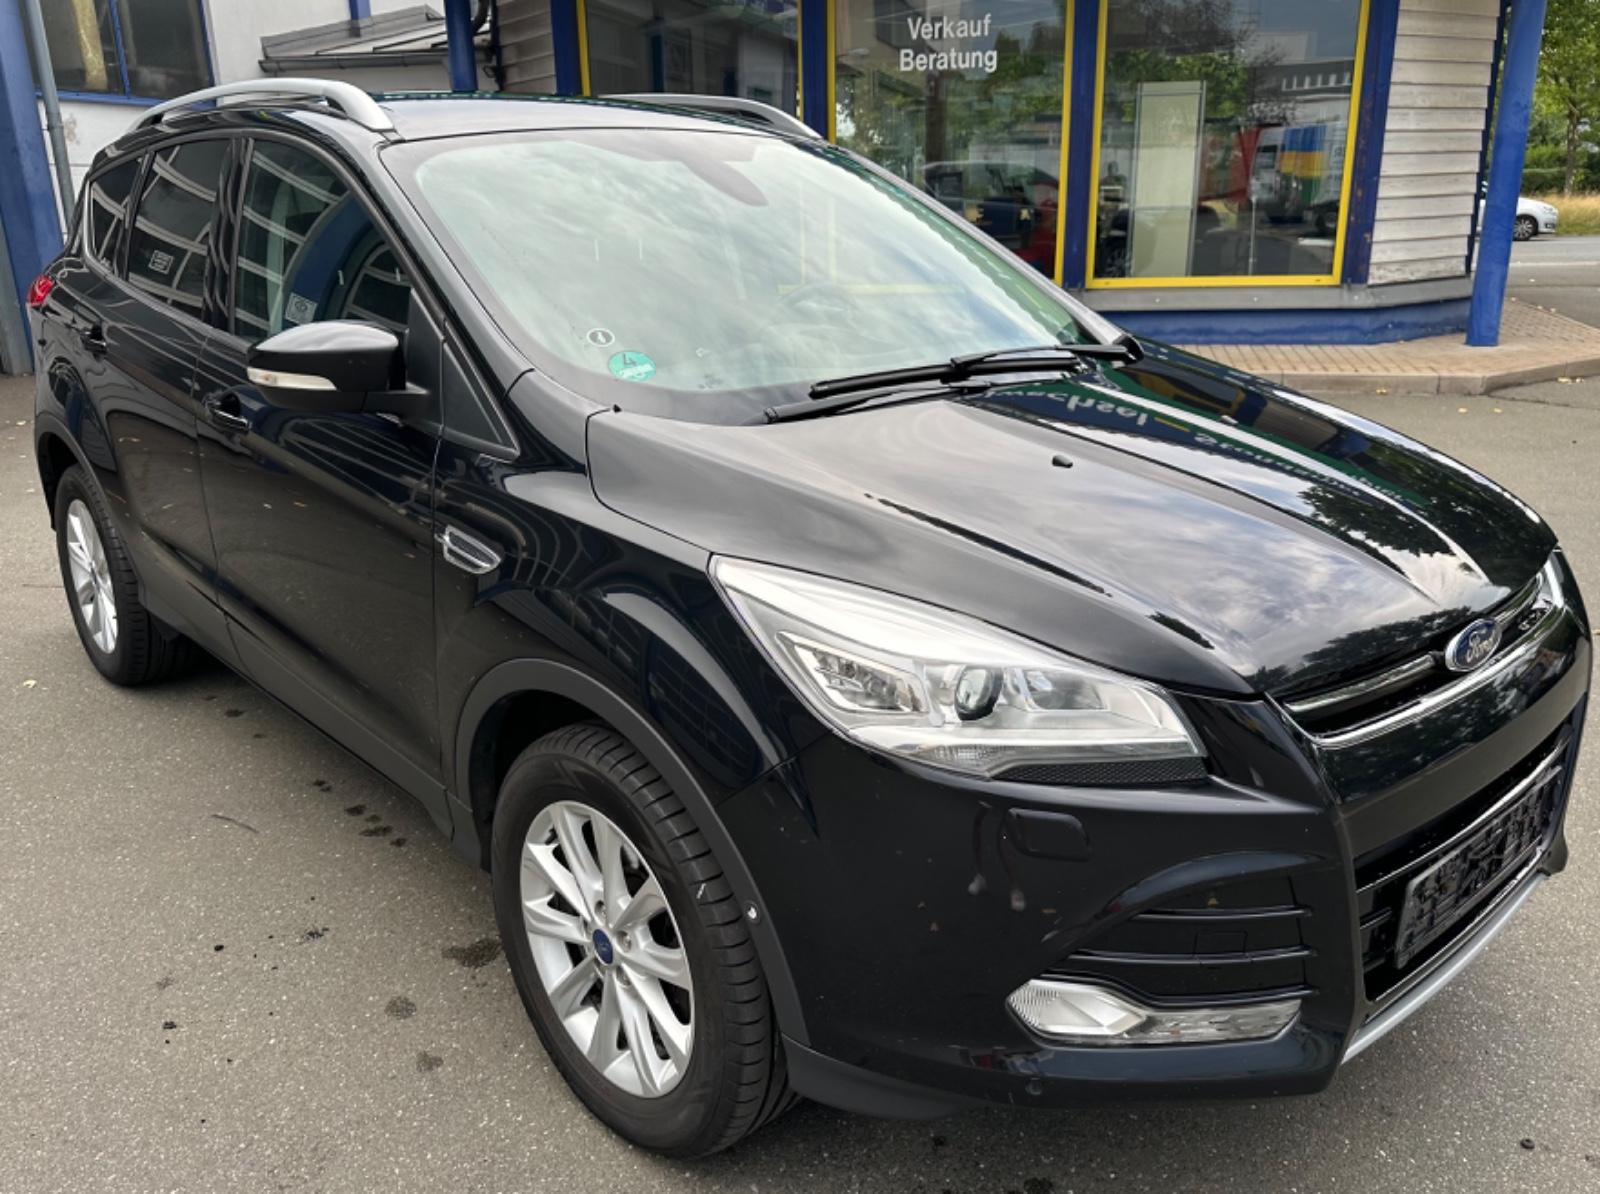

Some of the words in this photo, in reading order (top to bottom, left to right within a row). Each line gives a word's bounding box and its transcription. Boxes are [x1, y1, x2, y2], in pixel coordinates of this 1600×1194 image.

[907, 13, 992, 40] Verkauf
[900, 48, 998, 73] Beratung
[1466, 627, 1496, 664] Ford
